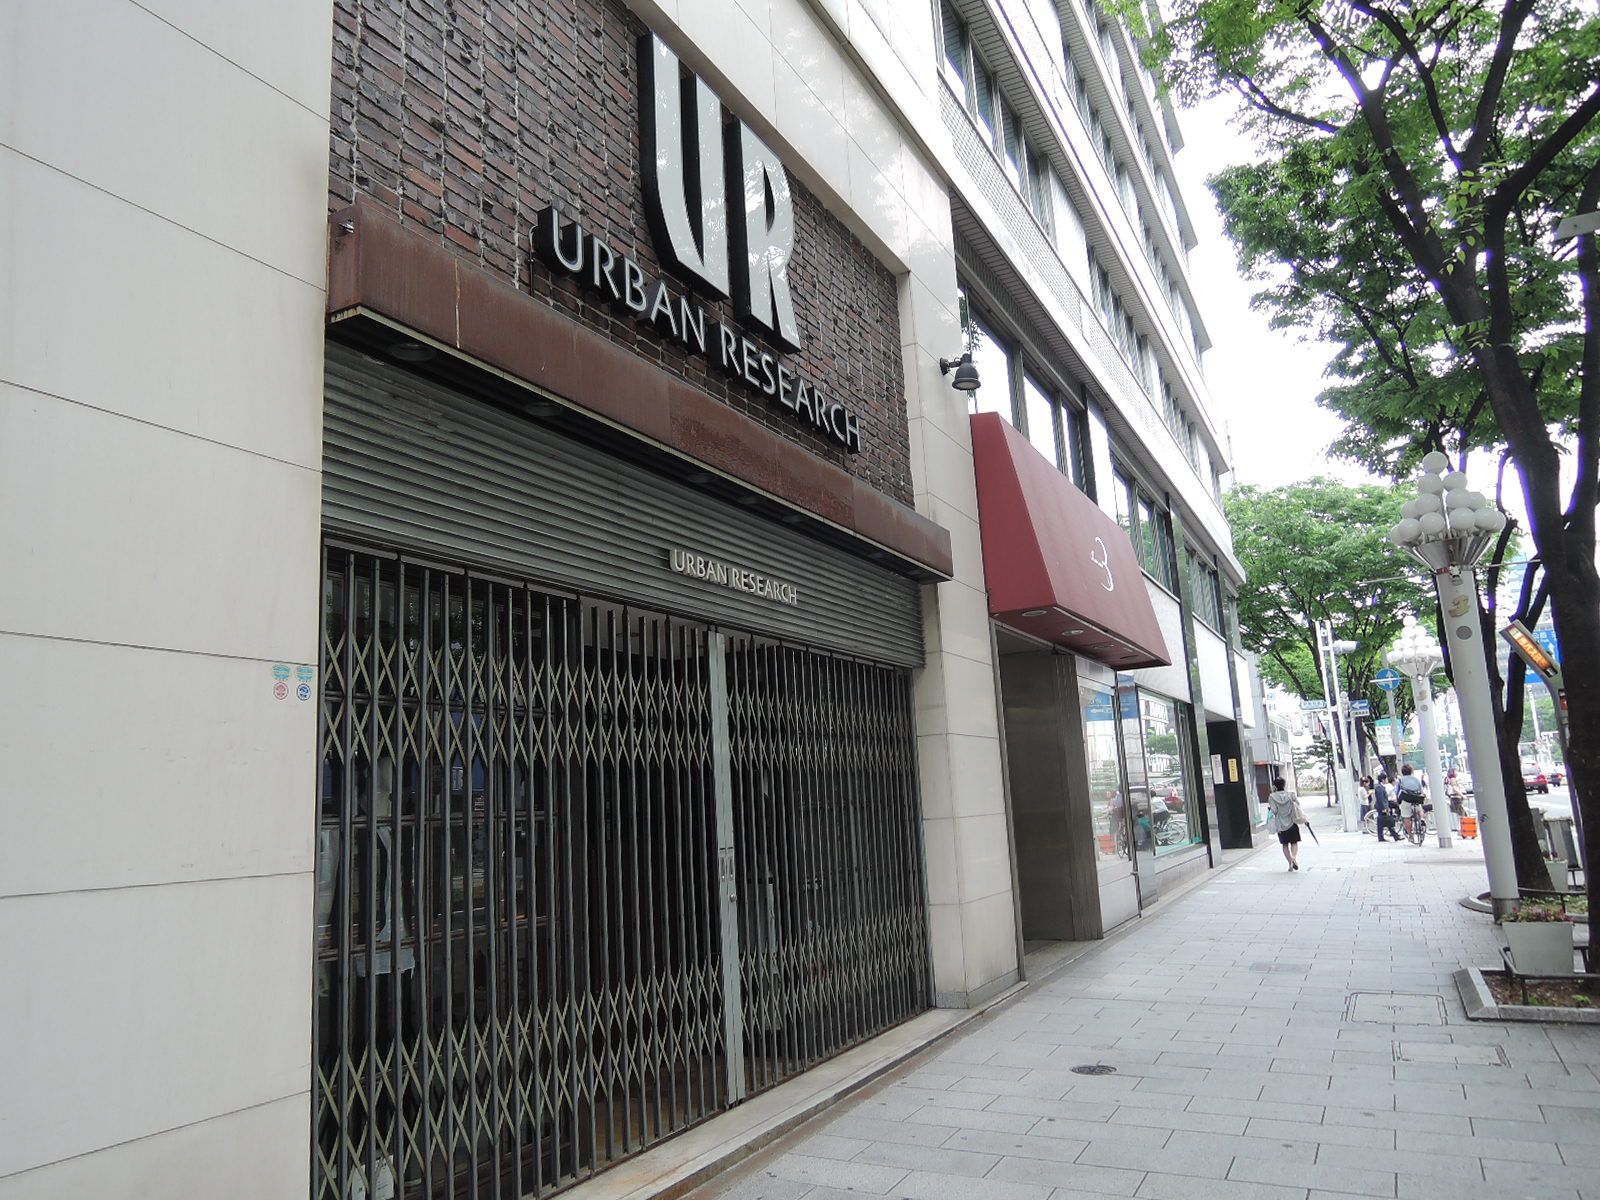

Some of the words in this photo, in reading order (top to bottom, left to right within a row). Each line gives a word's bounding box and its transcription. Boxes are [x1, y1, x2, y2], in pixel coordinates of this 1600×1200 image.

[541, 204, 707, 354] URBAN
[715, 321, 862, 453] RESEARCH
[670, 549, 728, 586] URBAN
[730, 567, 798, 605] RESEARCH
